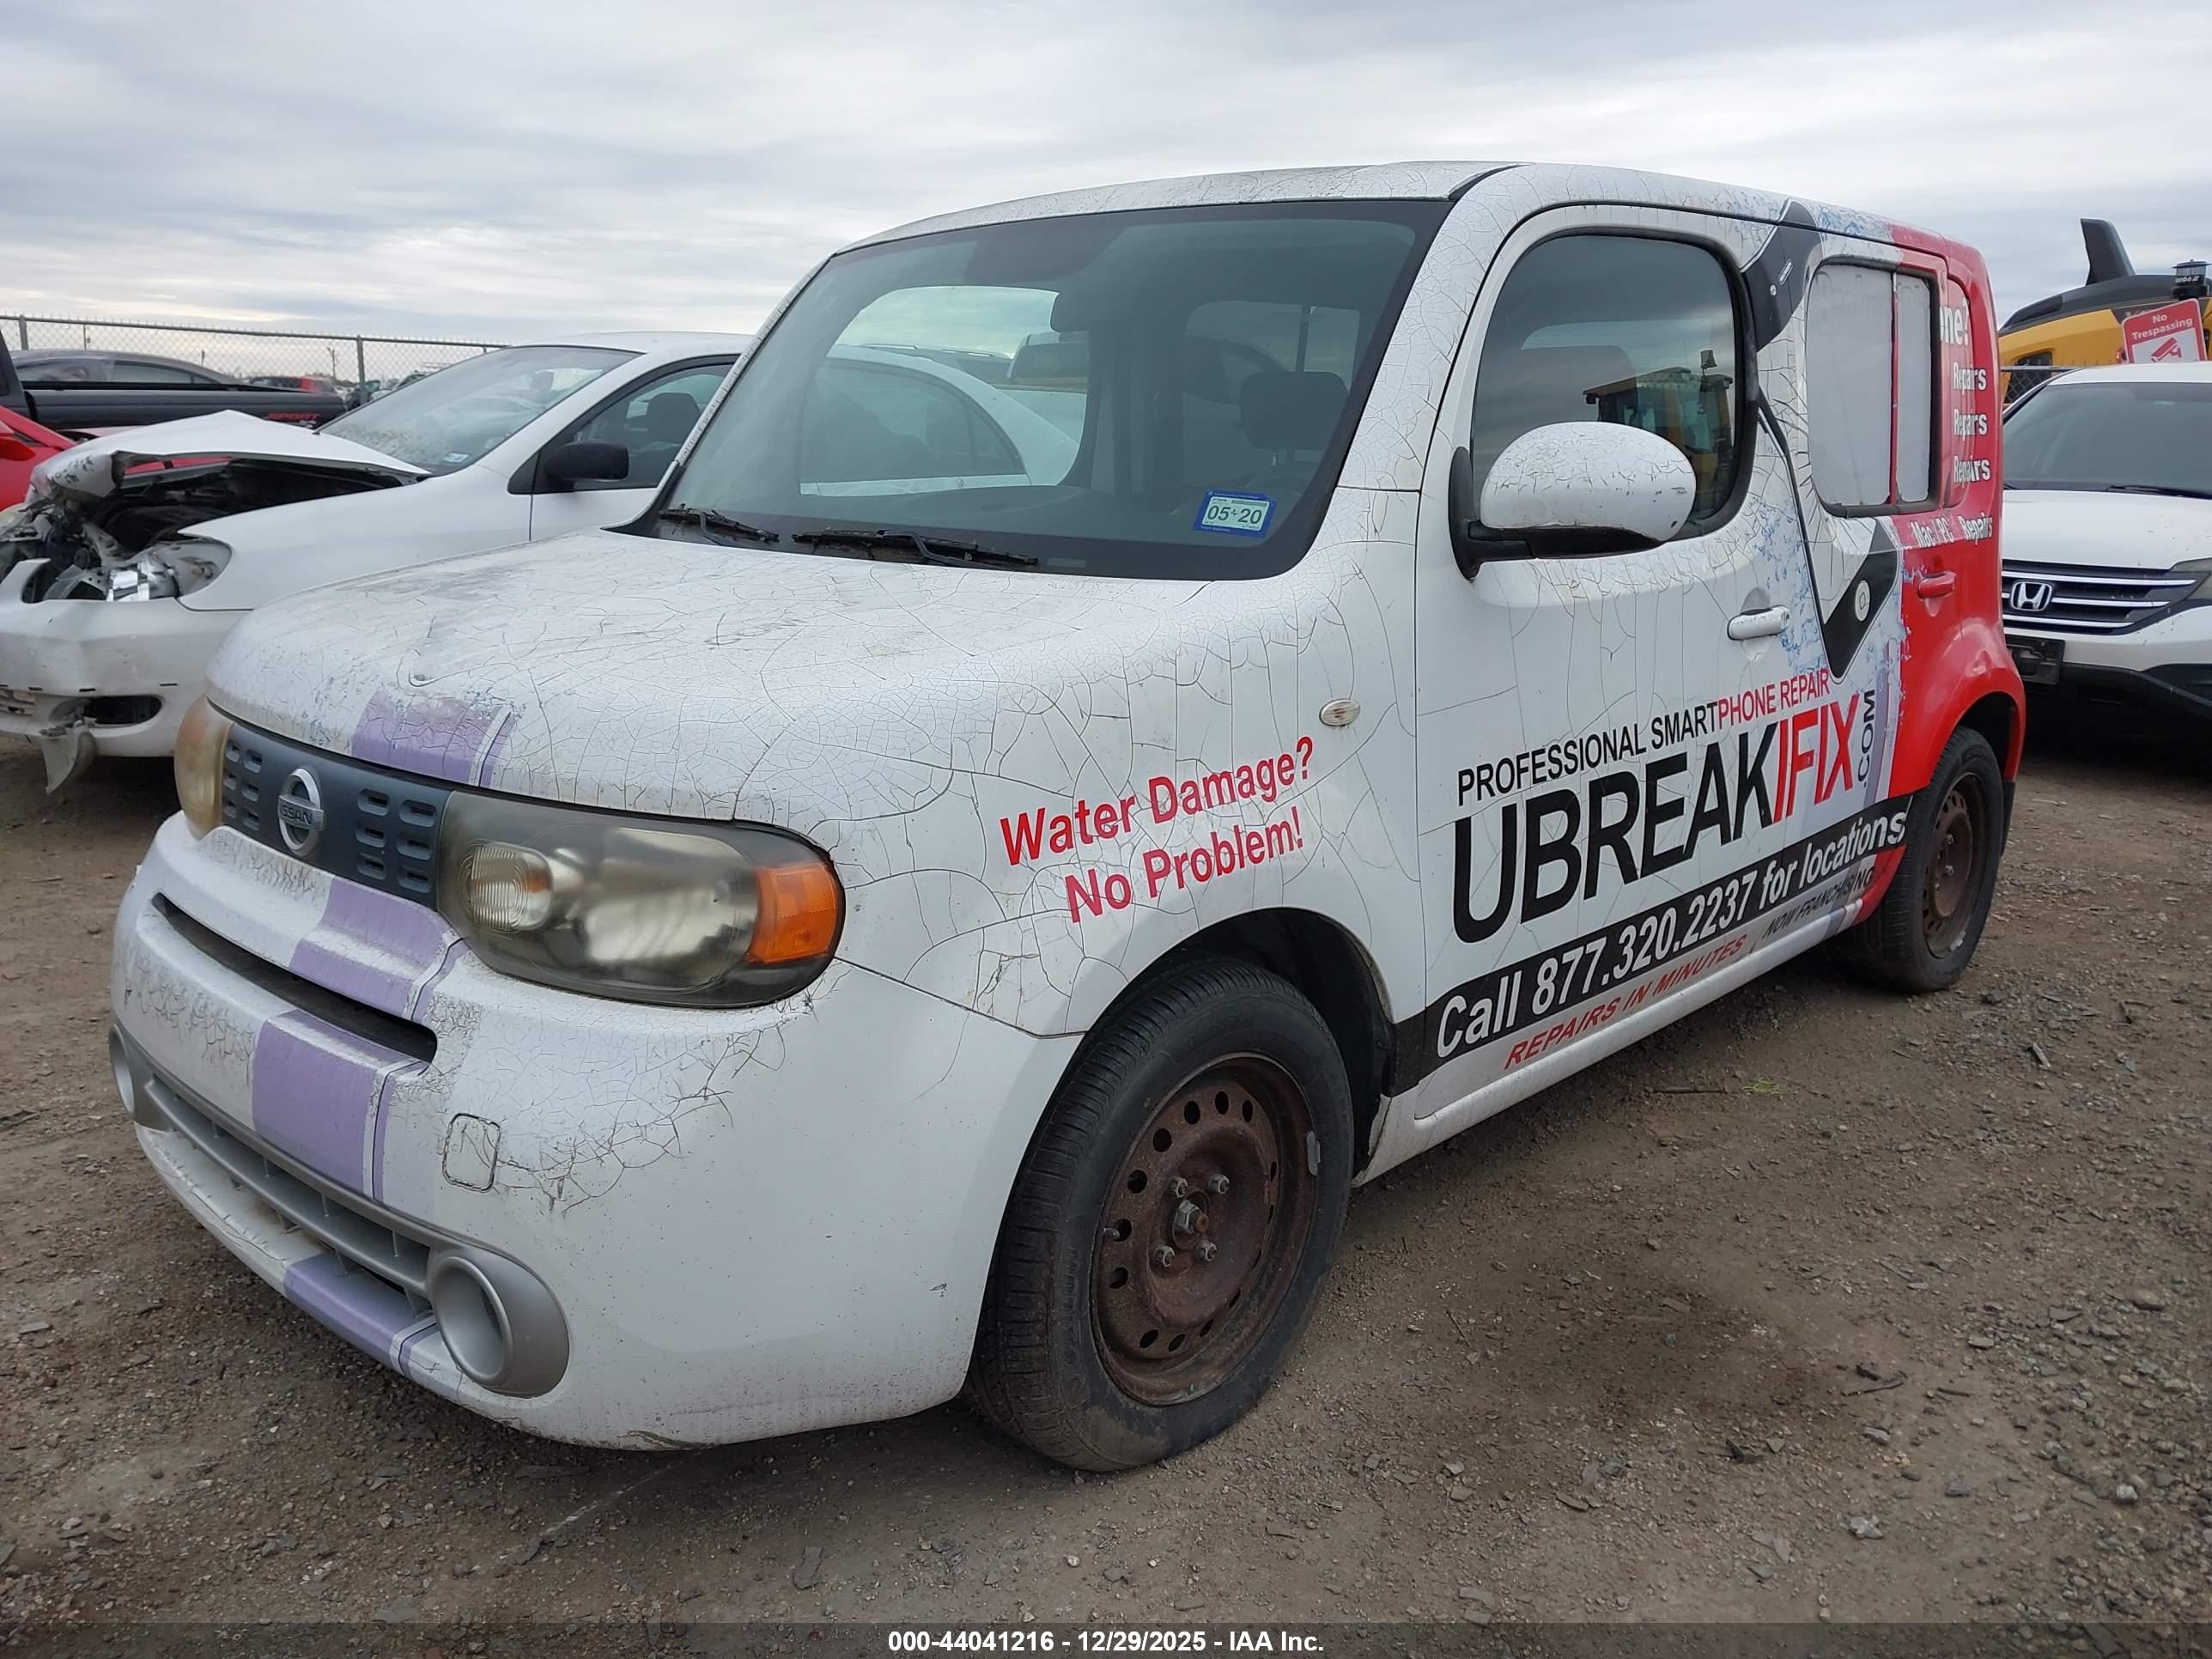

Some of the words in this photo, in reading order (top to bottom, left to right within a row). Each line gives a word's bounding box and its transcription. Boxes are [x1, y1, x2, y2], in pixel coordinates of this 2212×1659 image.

[2131, 318, 2193, 341] Trespassing
[2153, 314, 2167, 324] No
[1952, 362, 1987, 397] Repairs
[1953, 408, 1989, 442] Repairs
[1953, 454, 1991, 489] Repairs
[1957, 512, 1993, 546] Repairs
[1458, 723, 1647, 807] PROFESSIONAL
[1650, 684, 1777, 750] SMARTPHONE
[1780, 668, 1831, 710] REPAIR
[1000, 795, 1136, 866] Water
[1148, 736, 1314, 825] Damage?
[1453, 693, 1861, 945] UBREAKIFIX
[1064, 868, 1134, 924] No
[1142, 805, 1304, 899] Problem!
[1437, 970, 1522, 1059] Call
[1531, 869, 1759, 1016] 877.320.2237
[1759, 860, 1799, 910] for
[1799, 813, 1907, 890] locations
[1762, 908, 1796, 939] NOW
[1796, 866, 1875, 922] FRANCHISING
[1504, 996, 1623, 1071] REPAIRS
[1622, 981, 1654, 1012] IN
[1651, 933, 1749, 996] MINUTES
